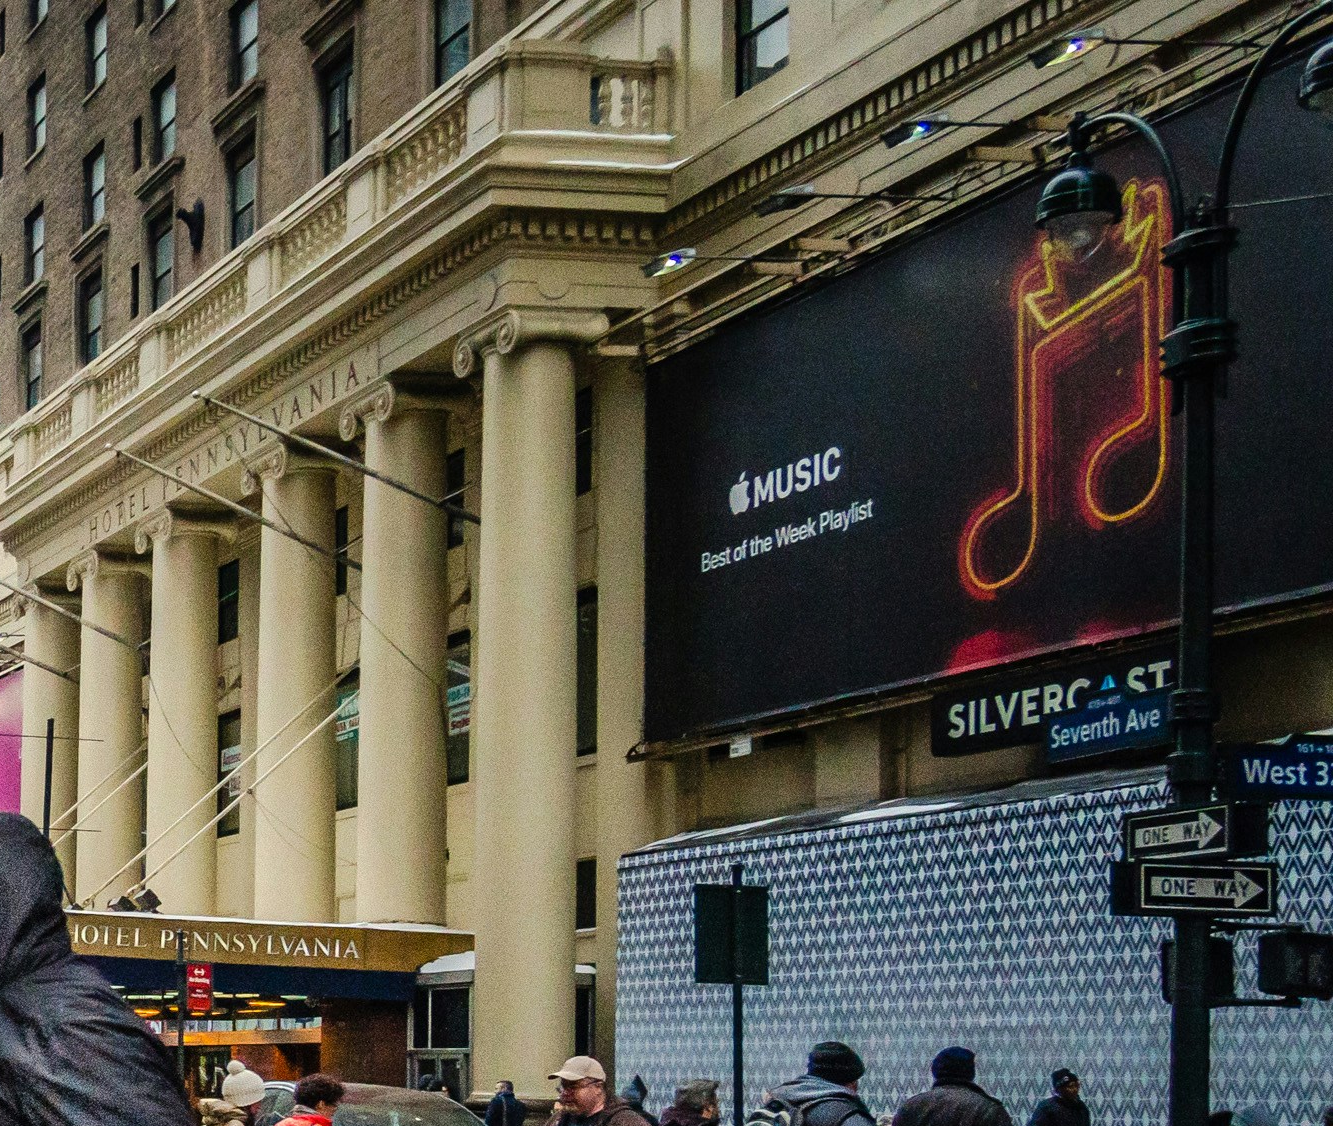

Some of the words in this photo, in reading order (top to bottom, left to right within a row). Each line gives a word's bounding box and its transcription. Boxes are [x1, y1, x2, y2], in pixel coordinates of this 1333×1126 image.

[753, 446, 841, 508] MUSIC
[89, 483, 148, 542] HOTEL
[701, 547, 731, 573] Best
[733, 540, 747, 562] of
[749, 535, 773, 557] the
[775, 517, 817, 548] Week
[819, 498, 874, 534] Playlist
[1050, 712, 1120, 749] Seventh
[1124, 706, 1161, 733] Ave
[1243, 758, 1307, 786] West
[1315, 761, 1333, 786] 3
[1142, 827, 1170, 845] ONE
[1183, 820, 1213, 839] WAY
[1161, 878, 1196, 895] ONE
[1213, 879, 1251, 898] WAY
[71, 923, 148, 948] HOTEL
[160, 928, 361, 959] PENNSYLVANIA
